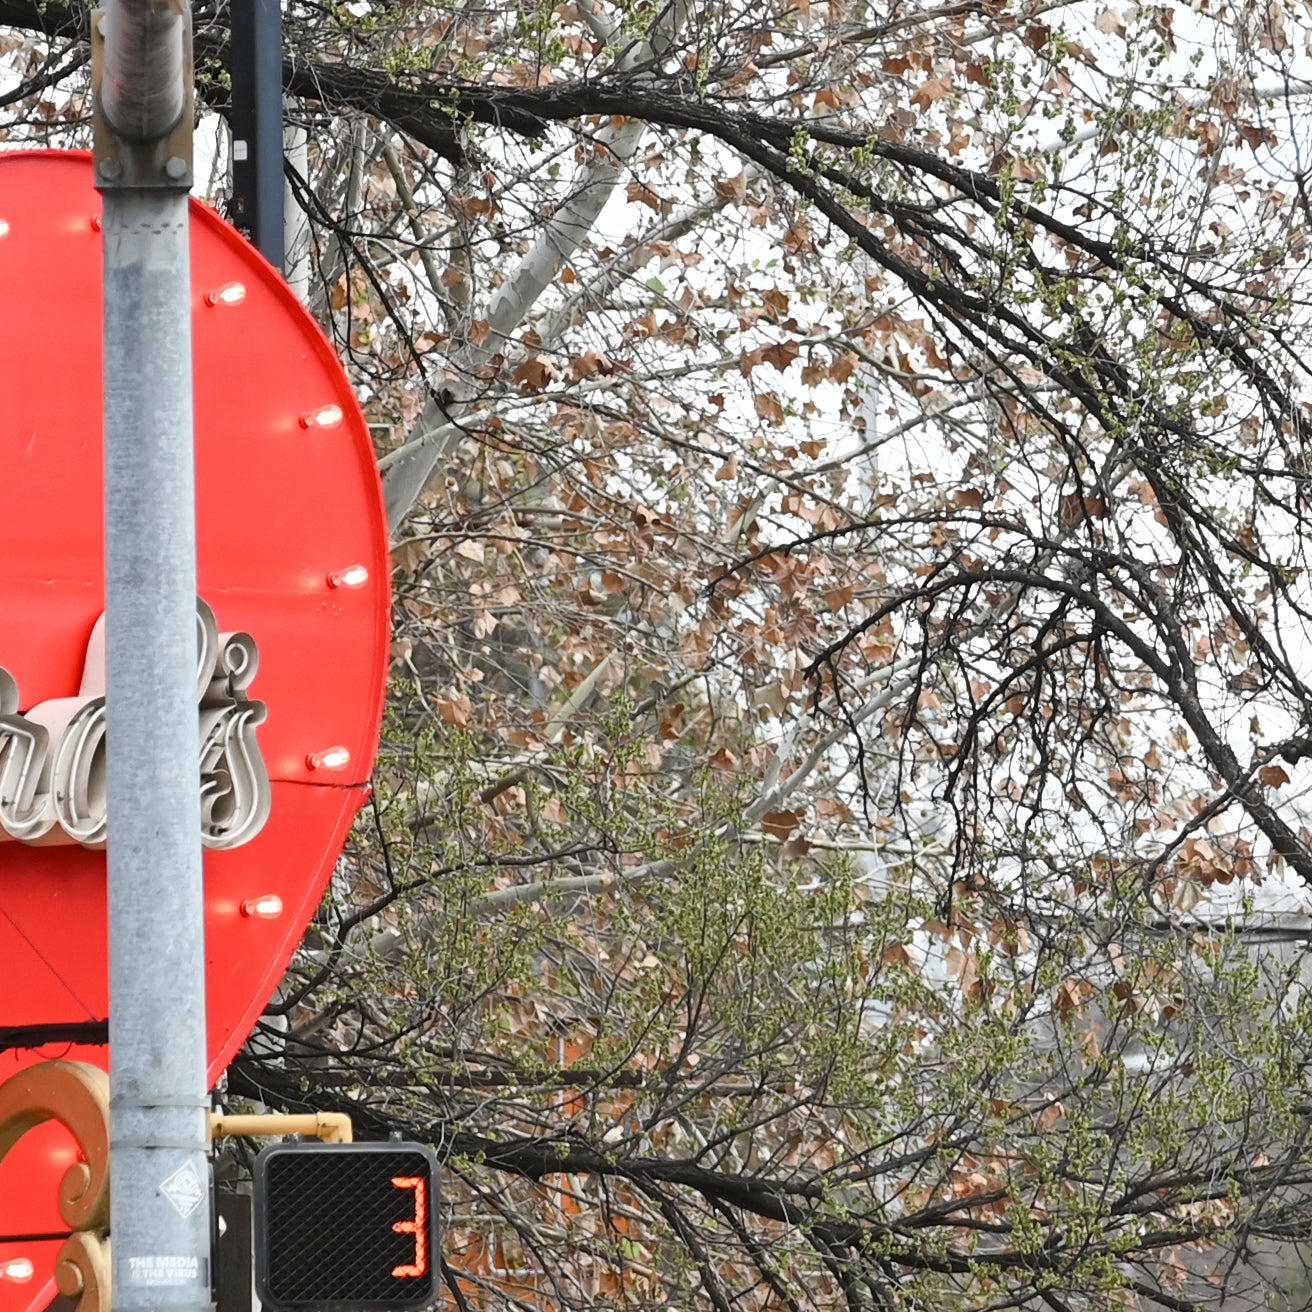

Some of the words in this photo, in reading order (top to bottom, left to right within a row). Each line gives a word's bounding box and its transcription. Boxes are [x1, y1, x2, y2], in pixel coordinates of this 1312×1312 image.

[391, 1176, 426, 1278] 3
[129, 1256, 153, 1269] THE
[156, 1256, 198, 1269] MEDIA
[143, 1269, 164, 1279] THE
